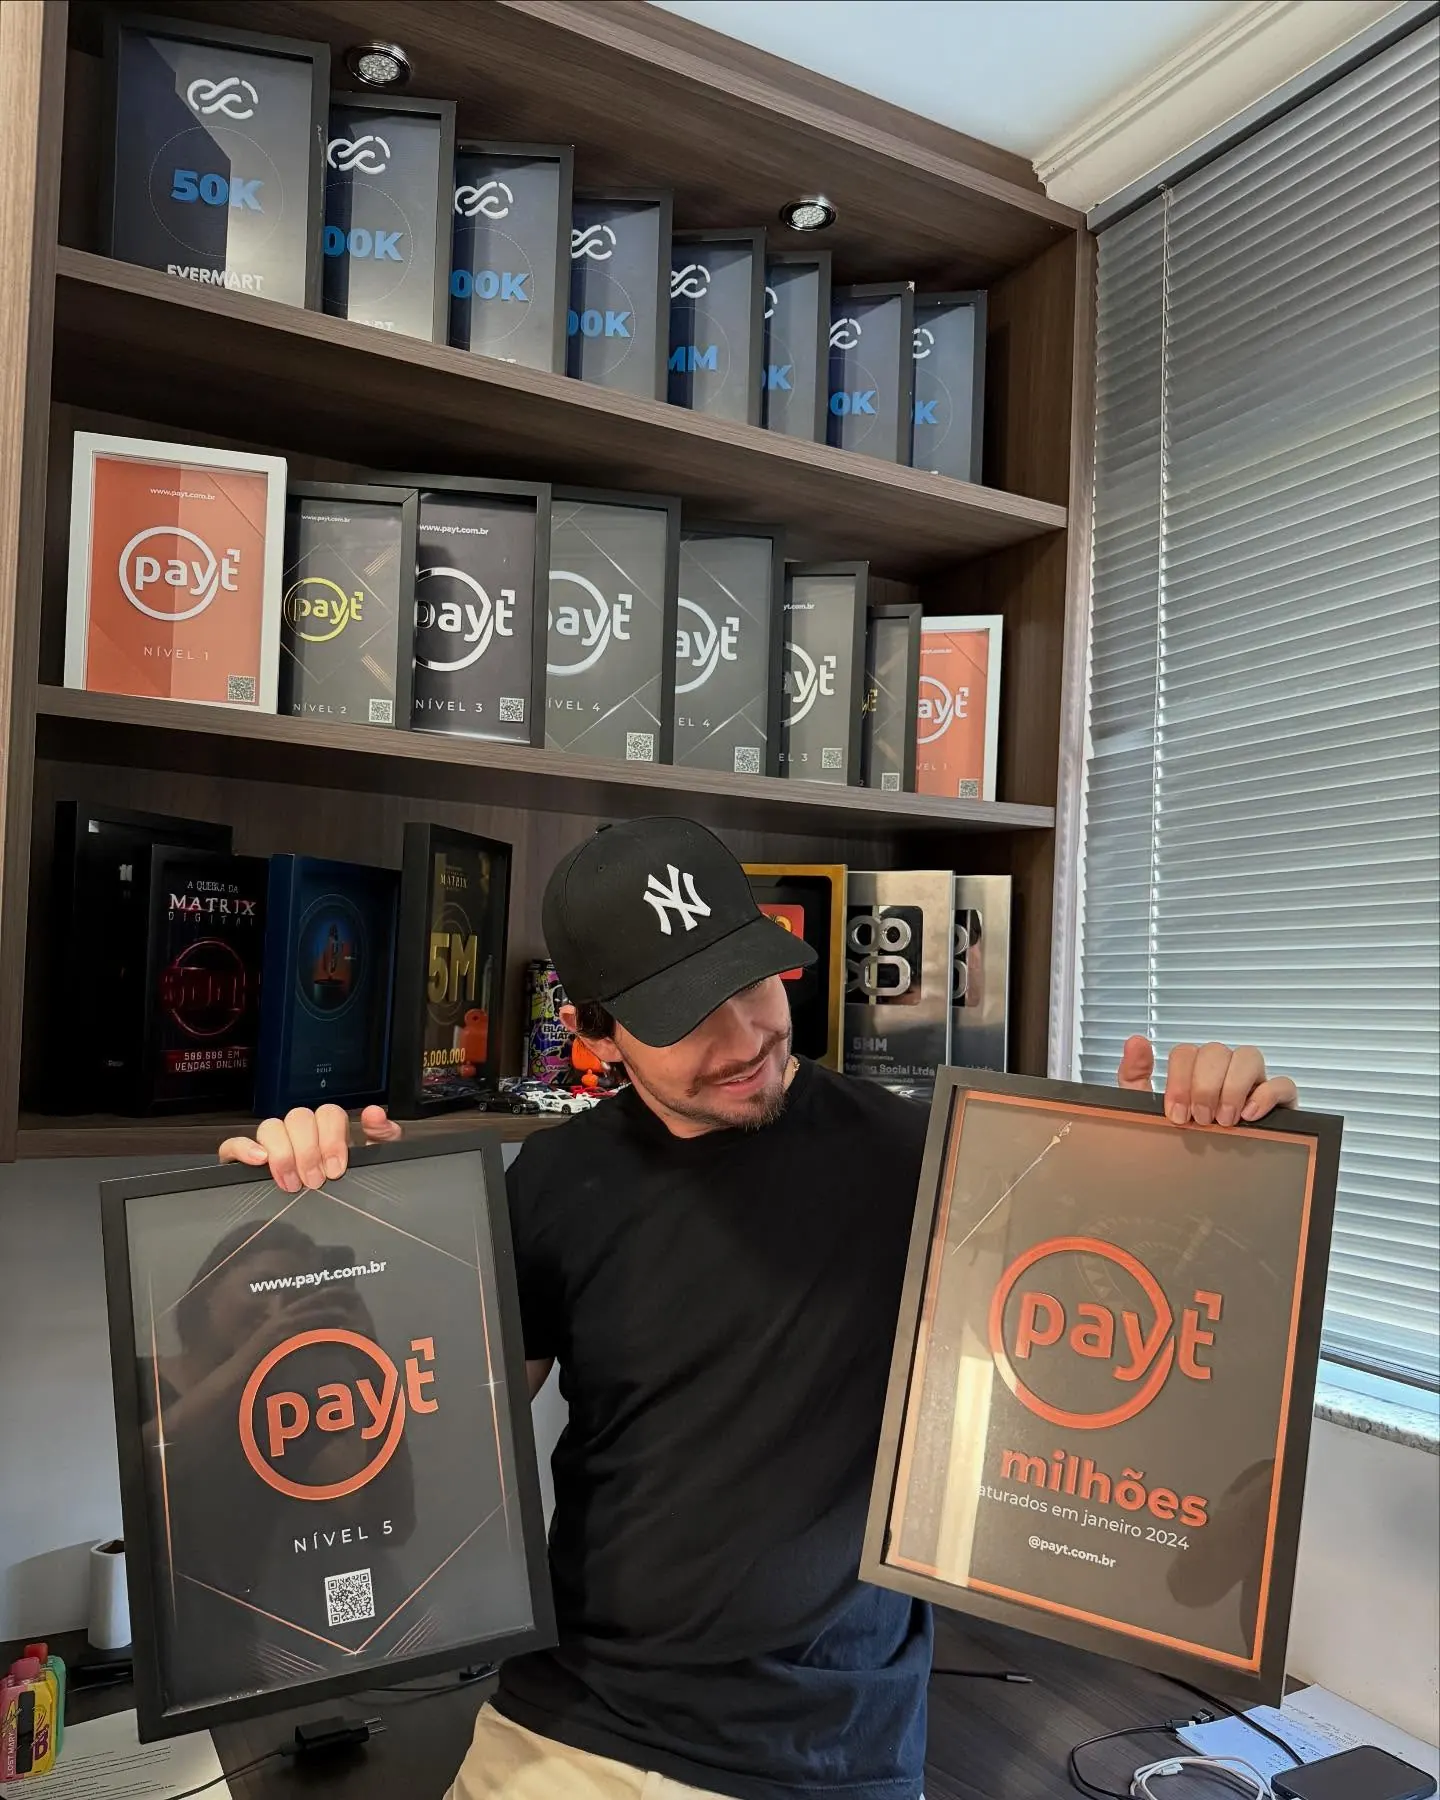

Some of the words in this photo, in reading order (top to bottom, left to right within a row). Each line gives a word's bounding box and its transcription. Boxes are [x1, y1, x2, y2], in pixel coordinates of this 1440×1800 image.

[171, 169, 265, 213] 50K
[167, 264, 265, 291] EVERMART
[762, 364, 793, 391] K
[150, 487, 216, 501] www.payt.com.br
[301, 514, 351, 523] www.payt.com.br
[419, 524, 489, 536] www.payt.com.br
[135, 549, 241, 596] payt
[294, 591, 364, 625] payt
[547, 593, 633, 647] ayt
[143, 646, 195, 660] NÍVEL
[204, 652, 209, 661] 1
[293, 703, 333, 714] NÍVEL
[340, 706, 347, 714] 2
[415, 698, 466, 712] NÍVEL
[475, 703, 483, 713] 3
[593, 702, 601, 712] 4
[702, 719, 711, 728] 4
[801, 753, 809, 762] 3
[187, 880, 194, 888] A
[196, 880, 226, 892] QUEBRA
[228, 884, 240, 894] DA
[168, 893, 257, 916] MATRIX
[427, 932, 478, 1002] 5M
[175, 1061, 211, 1072] VENDAS
[216, 1058, 249, 1069] ONLINE
[227, 1049, 240, 1059] EM
[879, 1063, 910, 1075] Social
[249, 1260, 387, 1293] www.payt.com.br
[1015, 1288, 1224, 1382] payt
[266, 1337, 439, 1457] payt
[1000, 1448, 1209, 1527] milhões
[294, 1525, 369, 1553] NÍVEL
[383, 1520, 393, 1535] 5
[1052, 1504, 1079, 1522] em
[1081, 1508, 1142, 1537] janeiro
[1145, 1527, 1190, 1551] 2024
[1028, 1535, 1117, 1568] @payt.com.br
[7, 1732, 15, 1755] MARY
